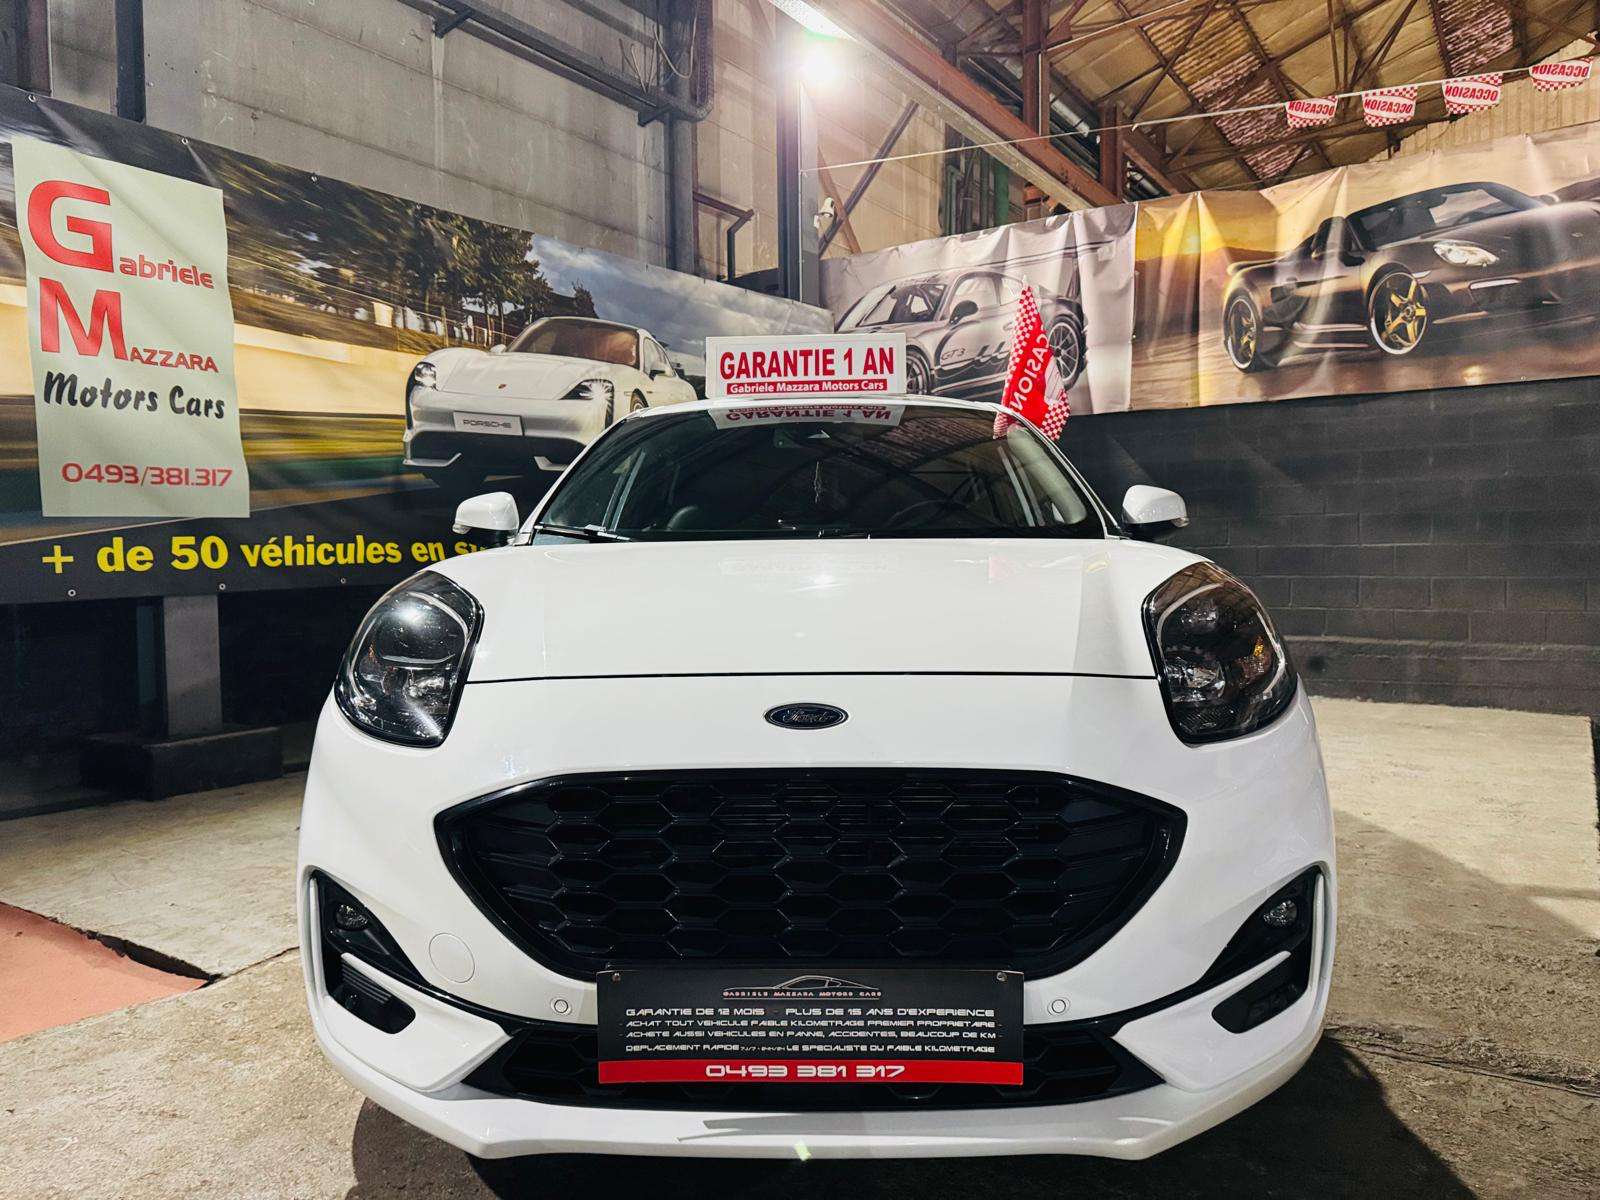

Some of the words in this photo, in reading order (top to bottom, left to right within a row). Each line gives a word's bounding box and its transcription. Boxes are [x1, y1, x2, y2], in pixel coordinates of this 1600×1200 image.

[27, 179, 214, 290] Gabriele
[38, 277, 220, 373] MAZZARA
[719, 349, 835, 380] GARANTIE
[843, 347, 853, 376] 1
[863, 347, 894, 375] AN
[42, 370, 159, 411] Motors
[168, 384, 225, 419] Cars
[730, 383, 774, 394] Gabriele
[776, 382, 820, 393] Mazzara
[821, 381, 859, 391] Motors
[861, 380, 884, 390] Cars
[463, 420, 512, 428] PORSCHE
[61, 461, 233, 488] 0493/381.317
[42, 544, 74, 574] +
[96, 536, 154, 573] de
[170, 534, 229, 570] 50
[239, 534, 402, 568] véhicules
[411, 539, 446, 563] en
[626, 1008, 692, 1016] GARANTIE
[696, 1008, 714, 1016] DE
[718, 1008, 730, 1016] 12
[734, 1008, 765, 1016] MOIS
[786, 1008, 822, 1016] PLUS
[826, 1008, 844, 1016] DE
[848, 1008, 862, 1016] 15
[866, 1008, 893, 1016] ANS
[897, 1008, 995, 1017] D'EXPERIENCE
[917, 1020, 995, 1028] PROPRIETAIRE
[626, 1044, 700, 1052] DEPLACEMENT
[924, 1045, 995, 1053] KILOMETRAGE
[706, 1064, 788, 1077] 0493
[797, 1065, 847, 1077] 381
[856, 1065, 905, 1077] 317
